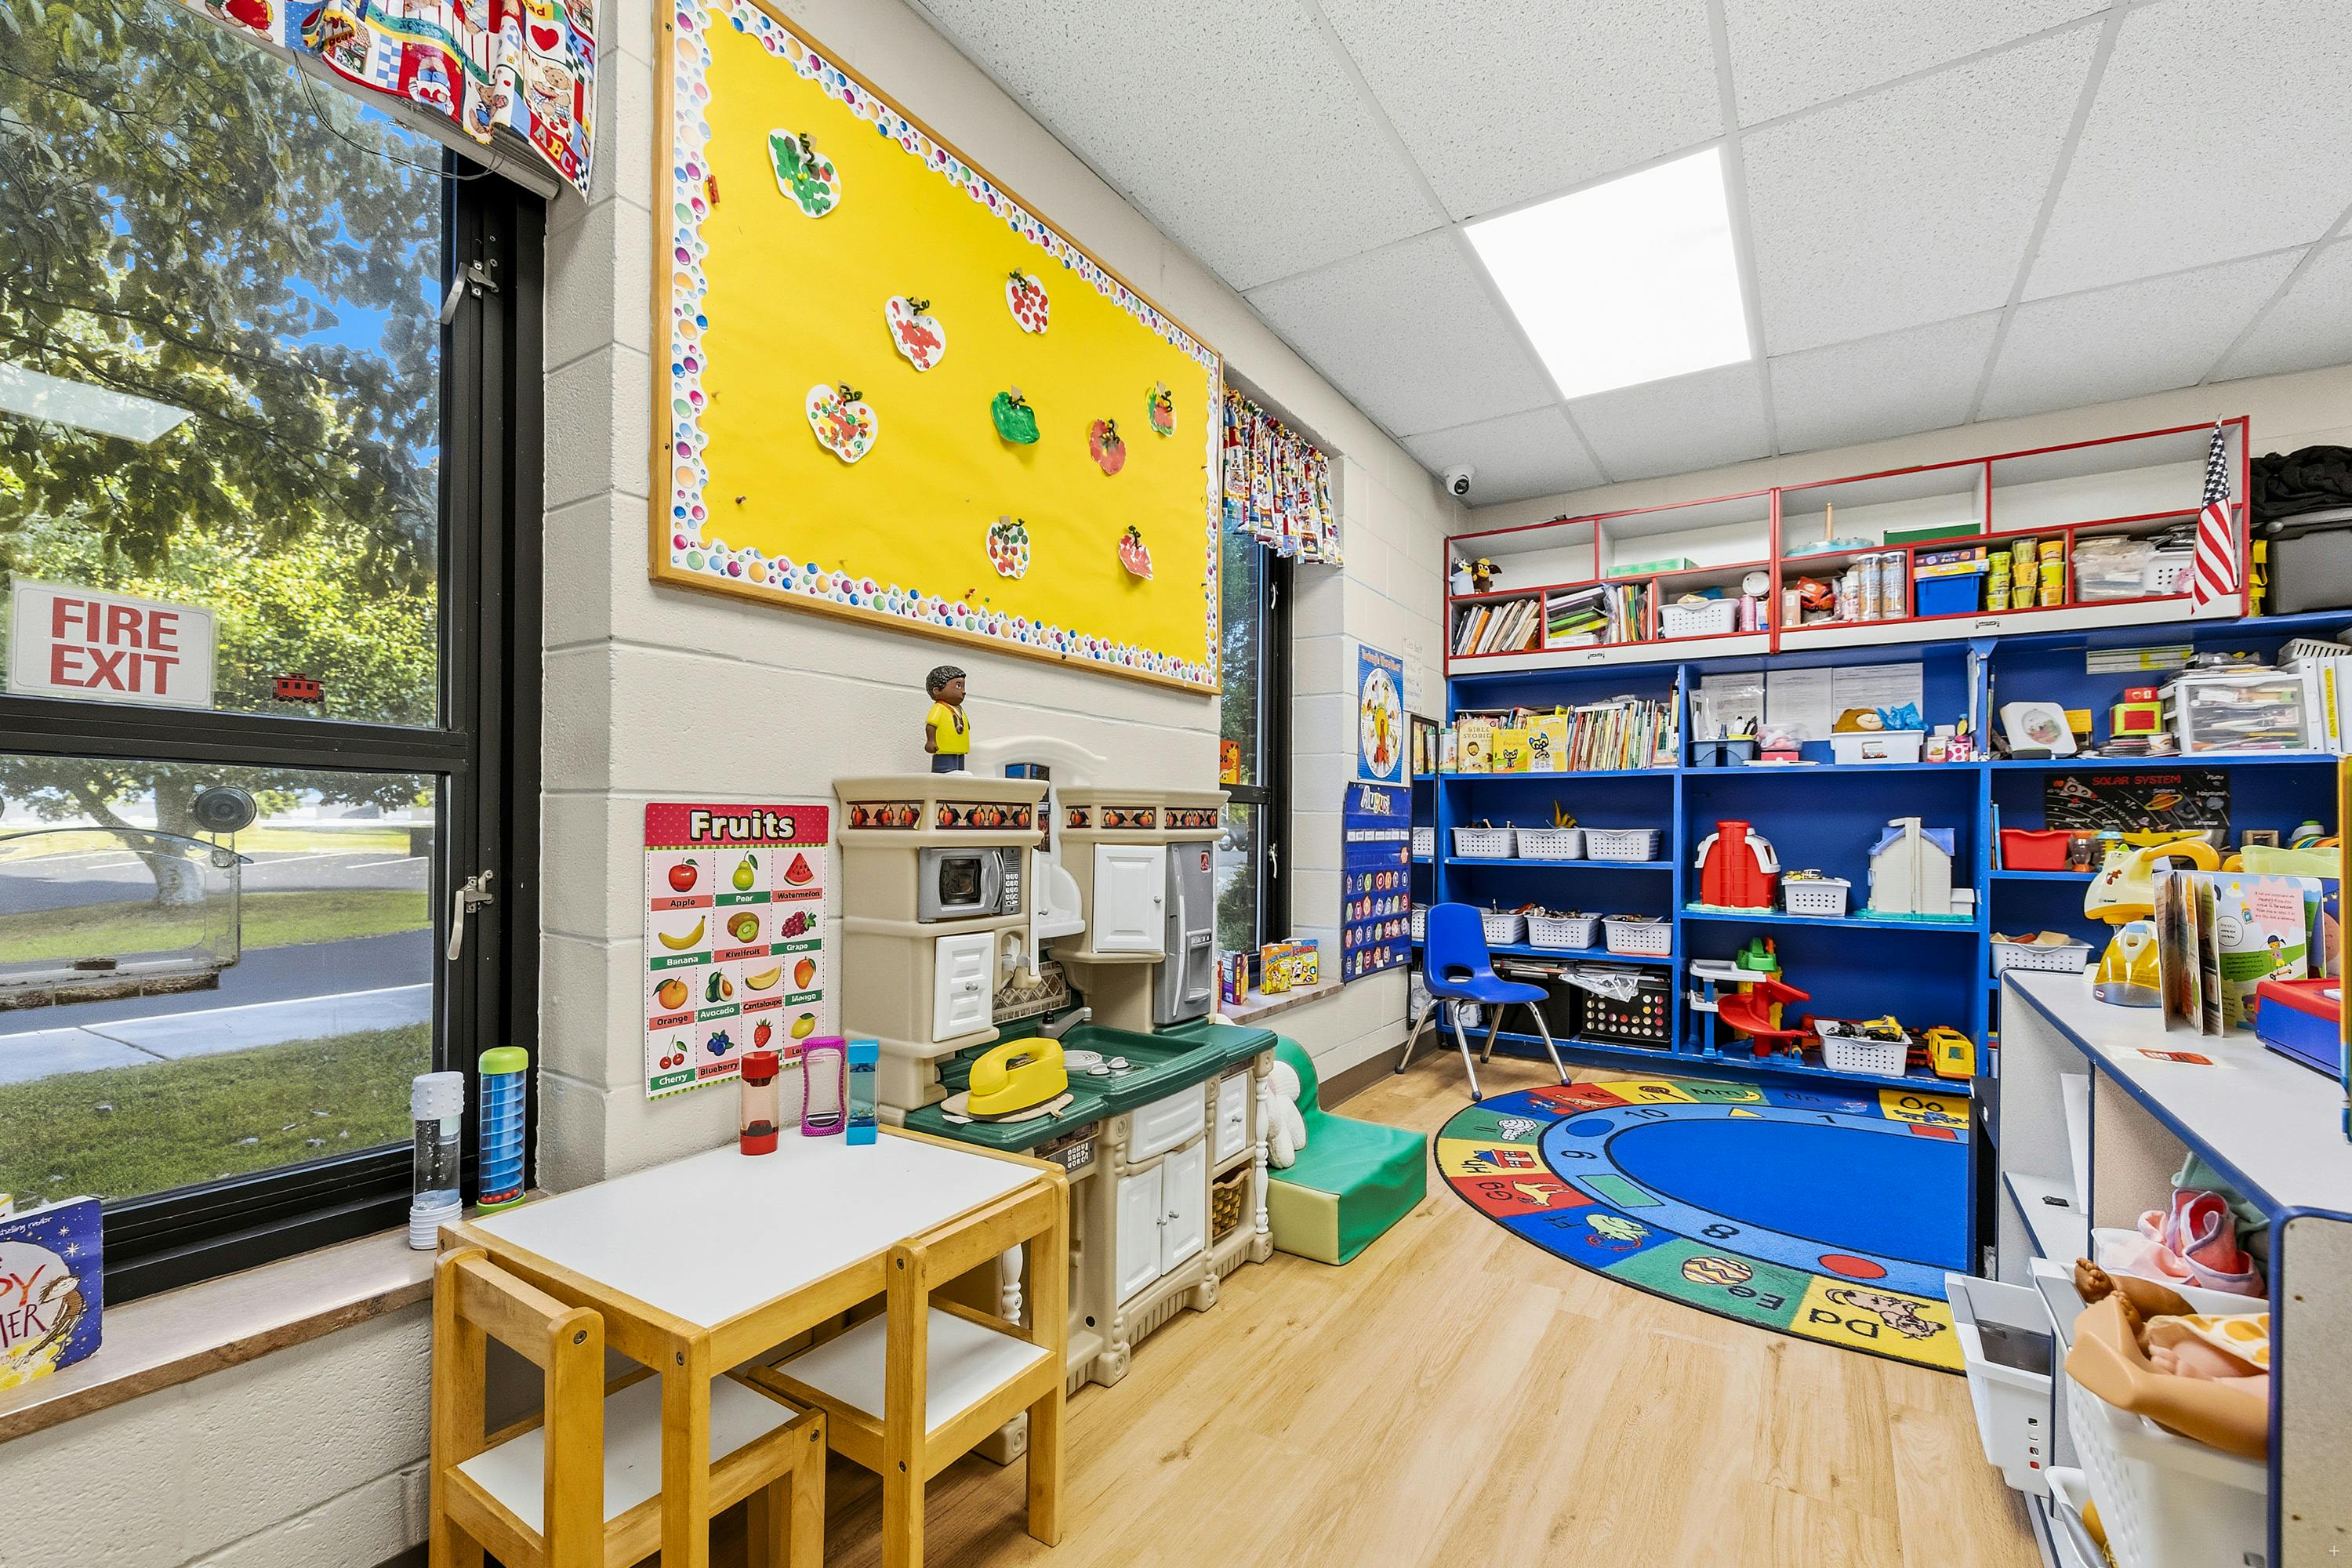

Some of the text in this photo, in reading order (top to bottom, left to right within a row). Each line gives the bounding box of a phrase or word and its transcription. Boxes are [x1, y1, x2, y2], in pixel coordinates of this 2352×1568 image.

[534, 125, 573, 172] ABC
[52, 597, 179, 652] FIRE
[51, 644, 180, 695] EXIT
[2092, 775, 2182, 786] SOLAR SYSTEM
[691, 809, 795, 840] Fruits
[670, 899, 695, 908] Apple
[777, 891, 820, 899] Watermelon
[666, 956, 699, 966] Banana
[786, 942, 808, 953] Grape
[657, 993, 816, 1026] Orange Avocado Cantaloupe Mango
[659, 1073, 688, 1087] Cherry
[700, 1062, 739, 1076] Blueberry
[1624, 1109, 1669, 1120] 10
[1900, 1097, 1944, 1112] Oo
[1461, 1160, 1492, 1174] Hh
[1476, 1181, 1513, 1200] Gg
[1701, 1224, 1740, 1239] 8
[1727, 1286, 1786, 1310] Ee
[1809, 1308, 1880, 1338] Dd
